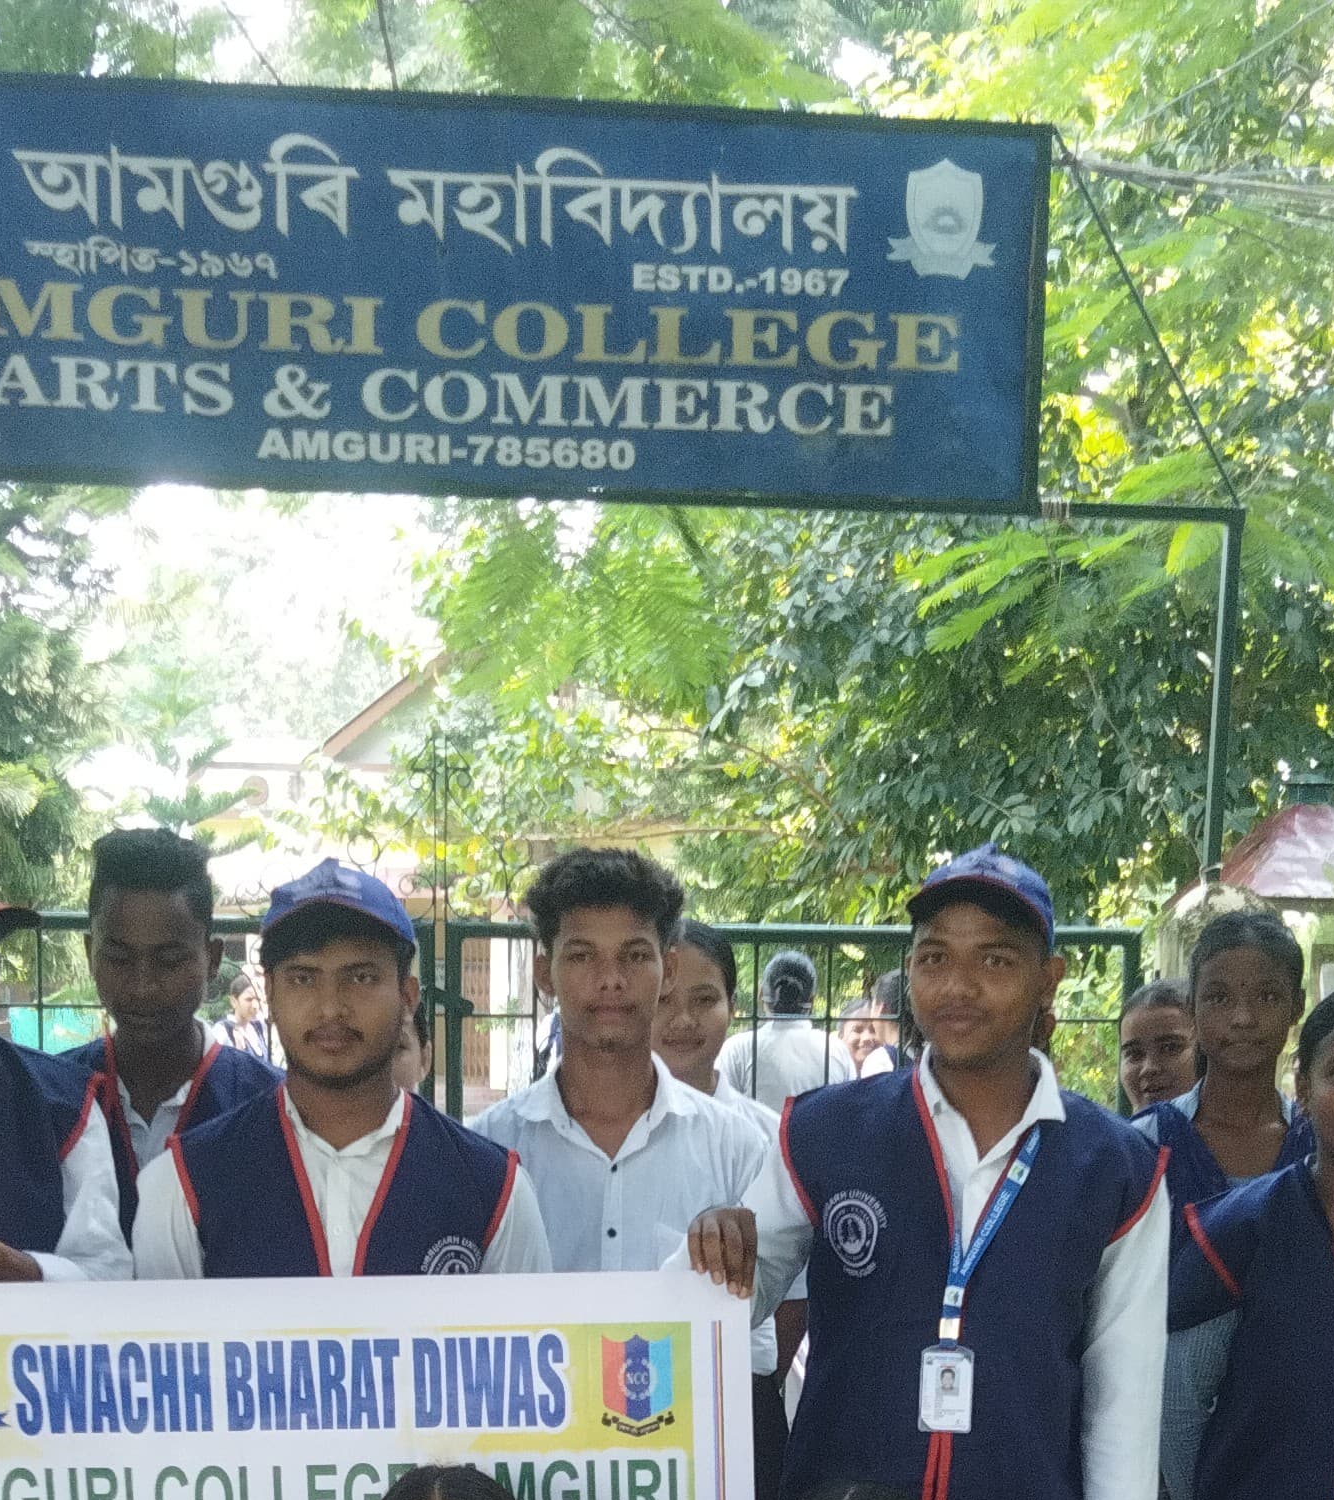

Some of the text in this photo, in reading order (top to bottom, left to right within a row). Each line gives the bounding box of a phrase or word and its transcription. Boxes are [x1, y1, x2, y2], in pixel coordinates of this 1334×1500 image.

[12, 132, 859, 255] আমগুৰি মহাবিদ্যালয়
[632, 263, 849, 296] ESTD.-1967
[417, 299, 960, 373] COLLEGE
[263, 364, 332, 420] &
[362, 368, 894, 436] COMMERCE
[257, 428, 636, 471] AMGURI-785680
[11, 1333, 569, 1435] SWACHH BHARAT DIWAS
